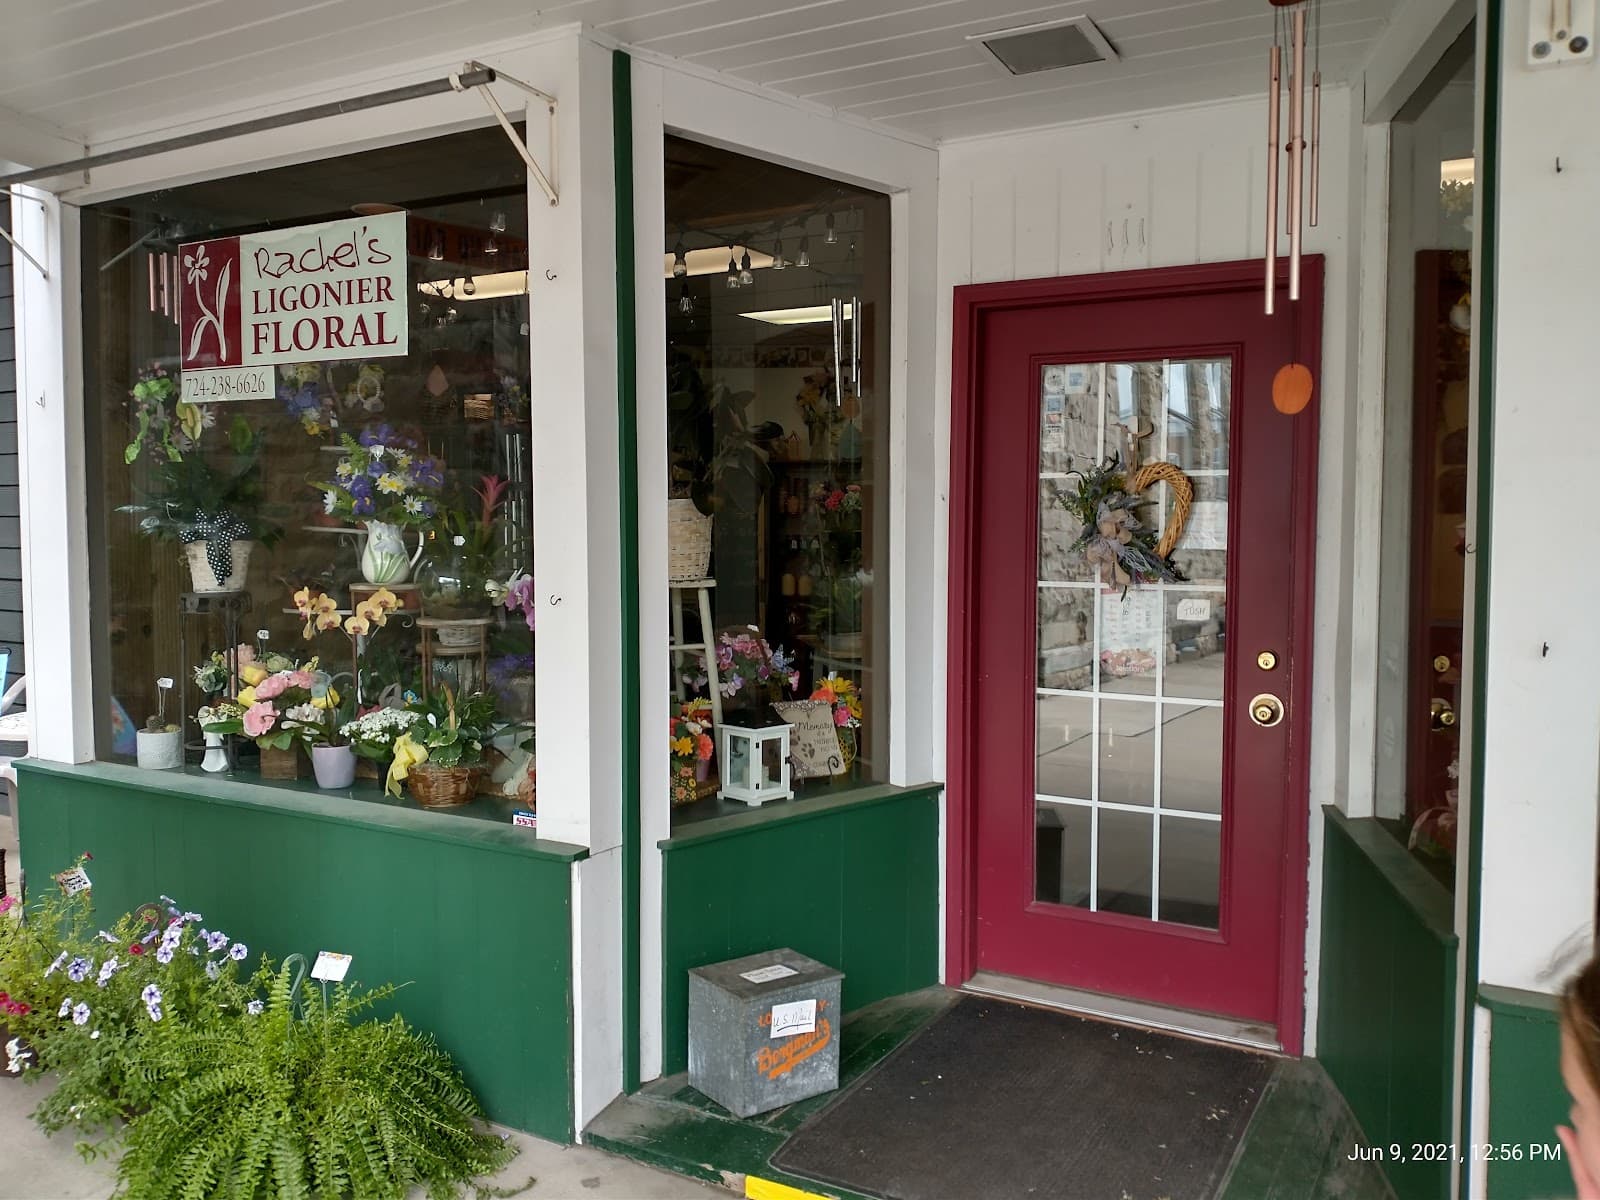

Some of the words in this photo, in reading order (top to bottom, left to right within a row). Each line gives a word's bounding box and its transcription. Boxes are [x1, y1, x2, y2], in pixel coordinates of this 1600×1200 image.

[253, 225, 393, 279] Rachel's
[251, 275, 395, 315] LIGONIER
[250, 311, 399, 355] FLORAL
[185, 371, 266, 397] 724-238-6626
